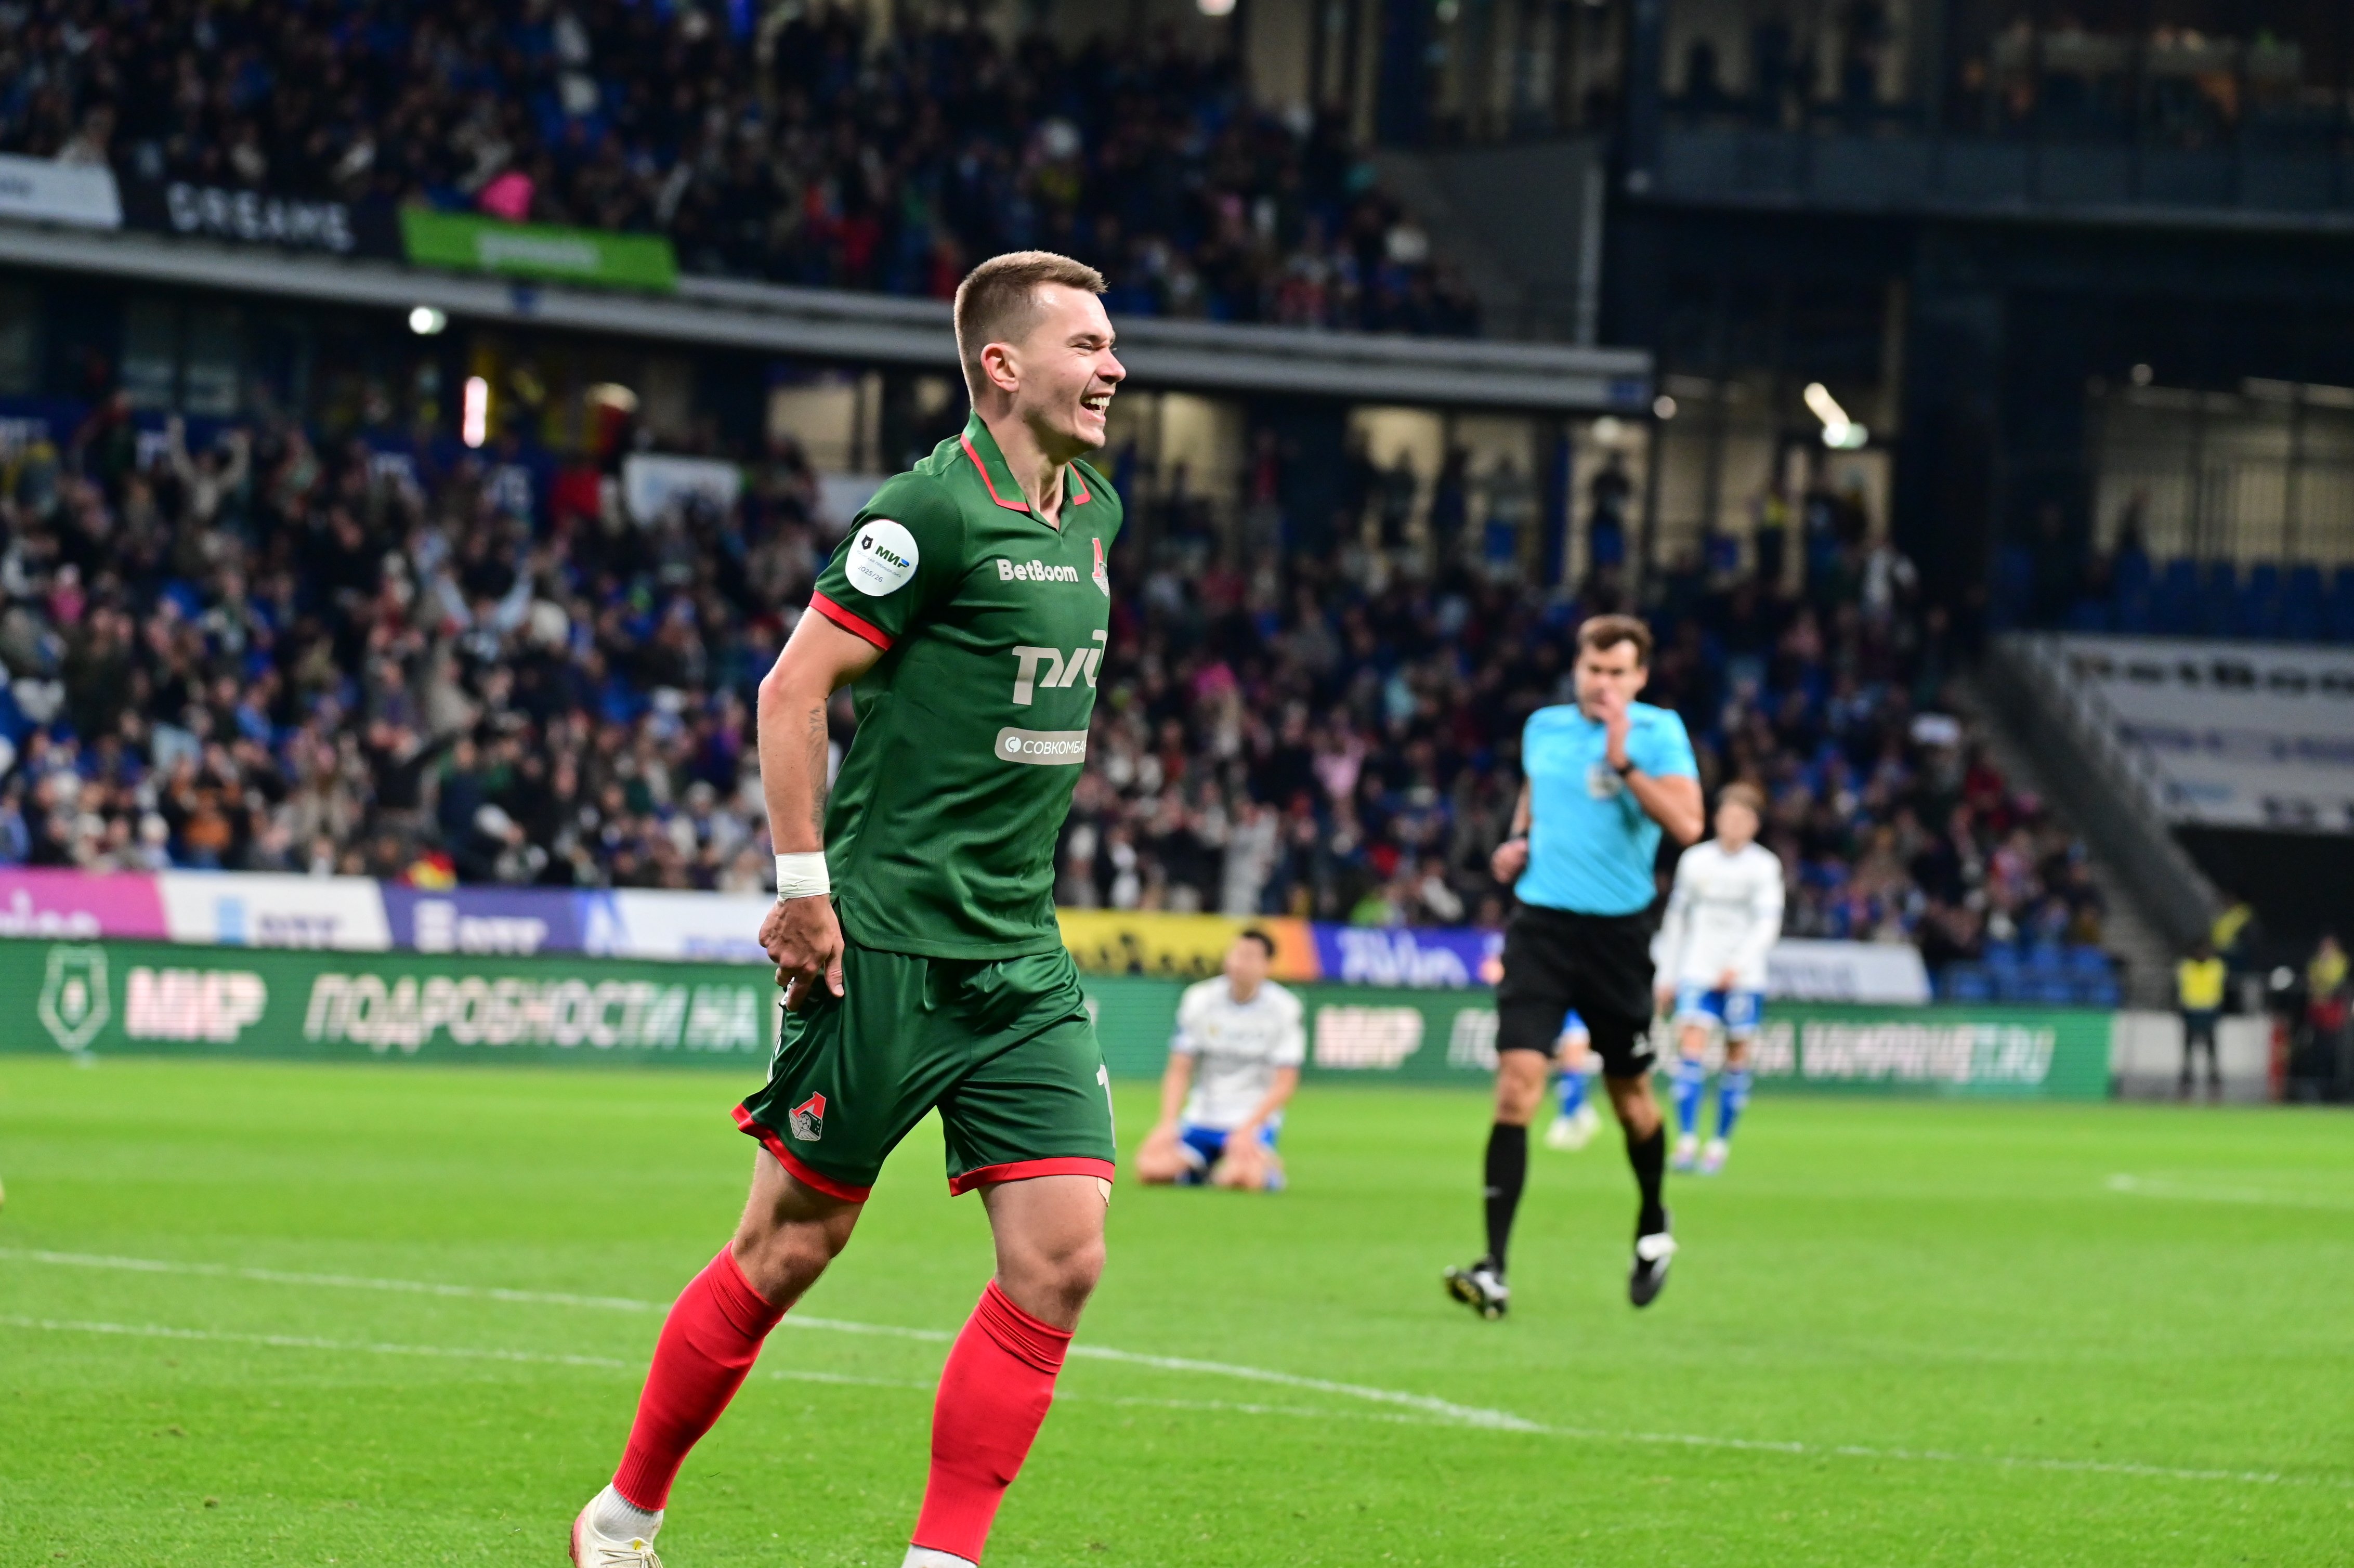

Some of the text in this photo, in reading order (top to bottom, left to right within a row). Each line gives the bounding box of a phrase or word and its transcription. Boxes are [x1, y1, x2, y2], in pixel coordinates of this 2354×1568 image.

[875, 545, 909, 568] МИР
[858, 565, 883, 582] 2025/26
[997, 559, 1079, 582] BetBoom
[125, 966, 760, 1053] МИР ПОДРОБНОСТИ НА
[1313, 1004, 1424, 1069] МИР
